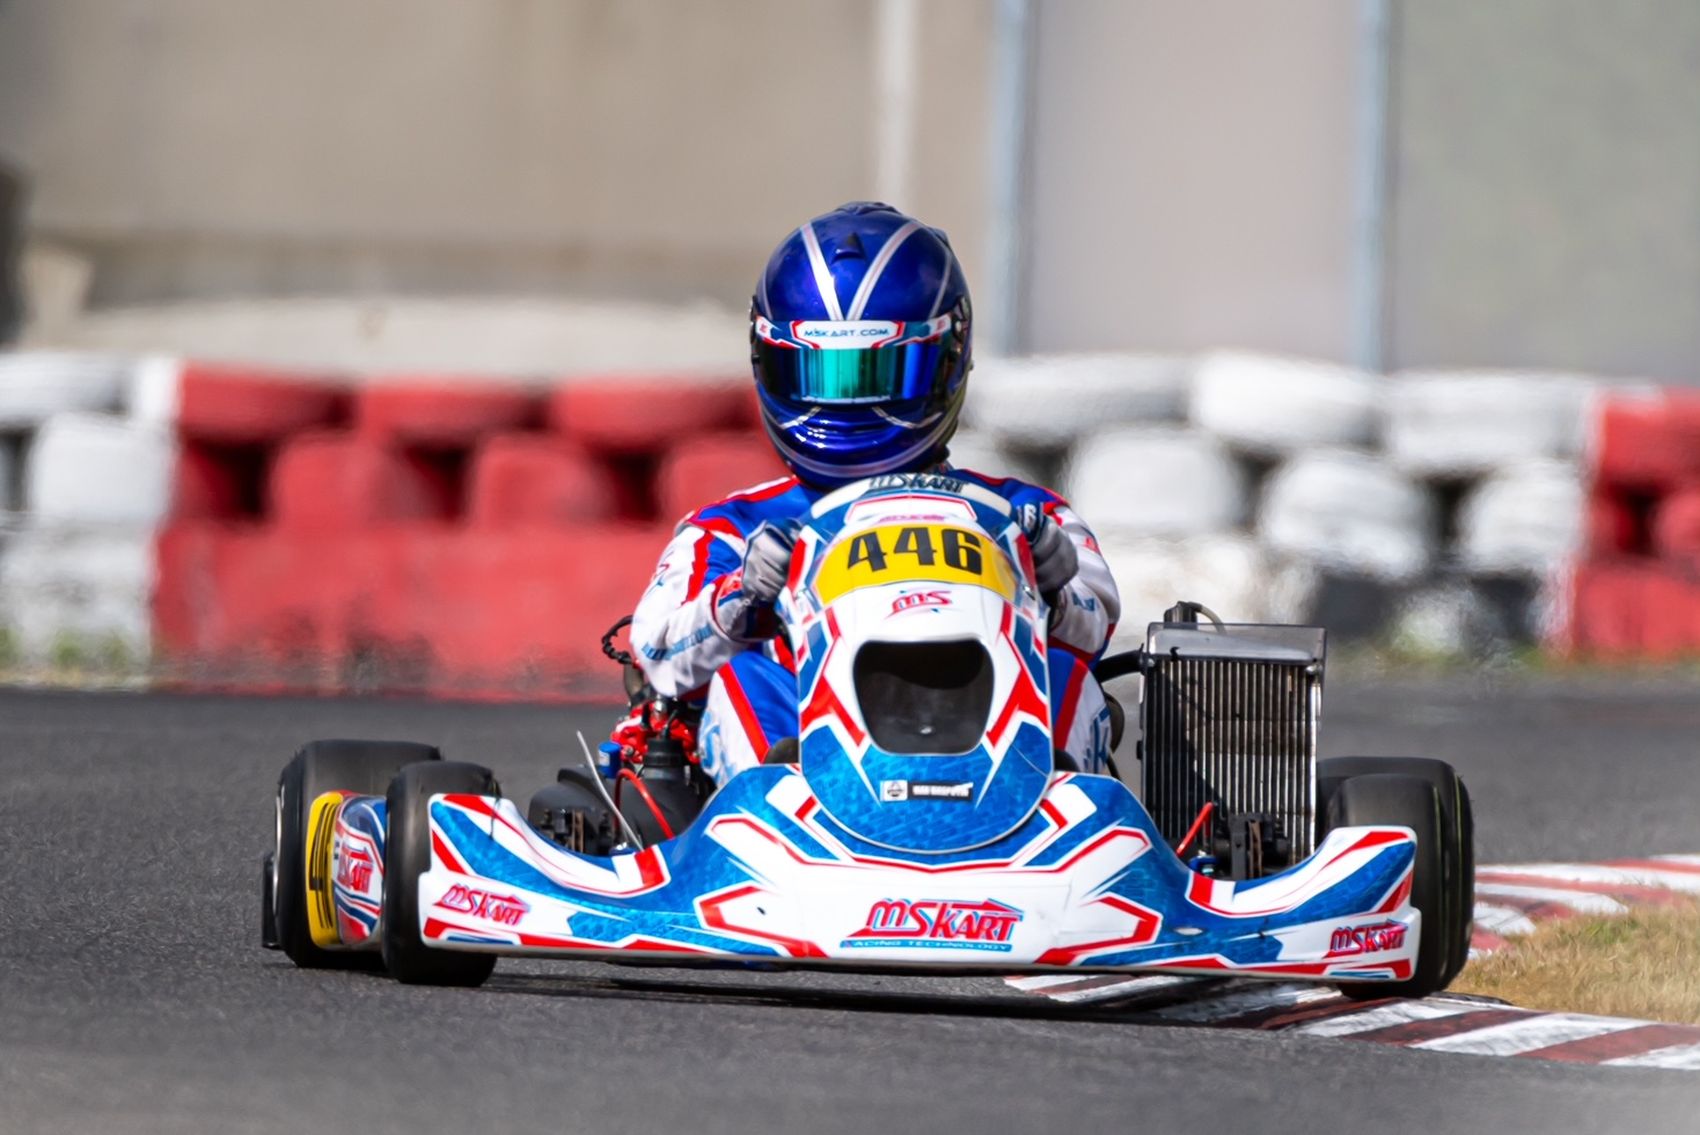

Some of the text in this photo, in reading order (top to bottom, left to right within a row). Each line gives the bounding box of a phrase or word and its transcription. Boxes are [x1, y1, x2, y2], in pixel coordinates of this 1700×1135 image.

[804, 327, 889, 337] MSKART.COM
[847, 527, 983, 576] 446
[433, 883, 531, 926] MSKART
[846, 898, 1024, 942] MSKART
[907, 939, 1010, 951] TECHNOLOGY
[1322, 919, 1408, 959] MSKART
